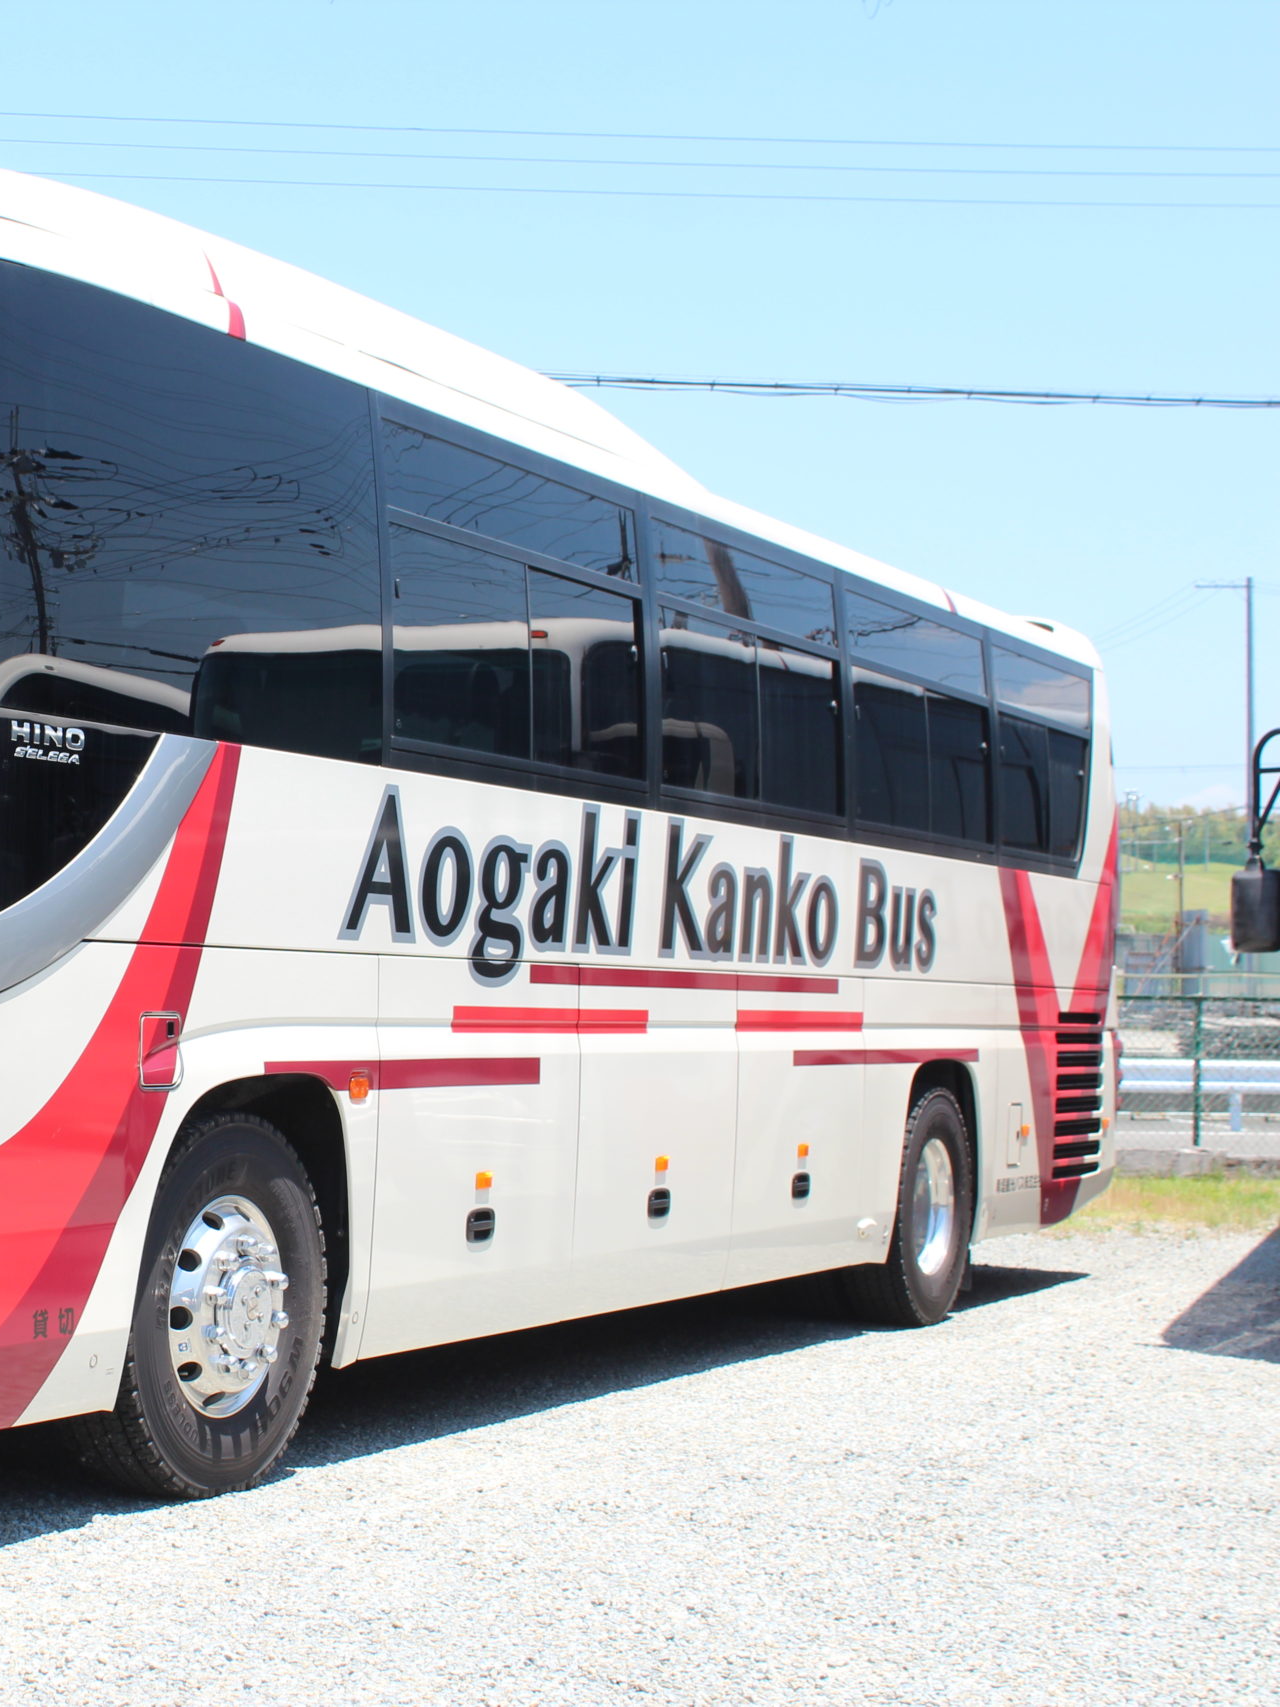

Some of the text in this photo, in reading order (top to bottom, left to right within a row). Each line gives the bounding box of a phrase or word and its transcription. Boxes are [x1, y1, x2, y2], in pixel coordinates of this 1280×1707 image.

[11, 720, 85, 751] HINO
[337, 784, 938, 987] Aogaki Kanko Bus
[33, 1307, 75, 1339] 貸切
